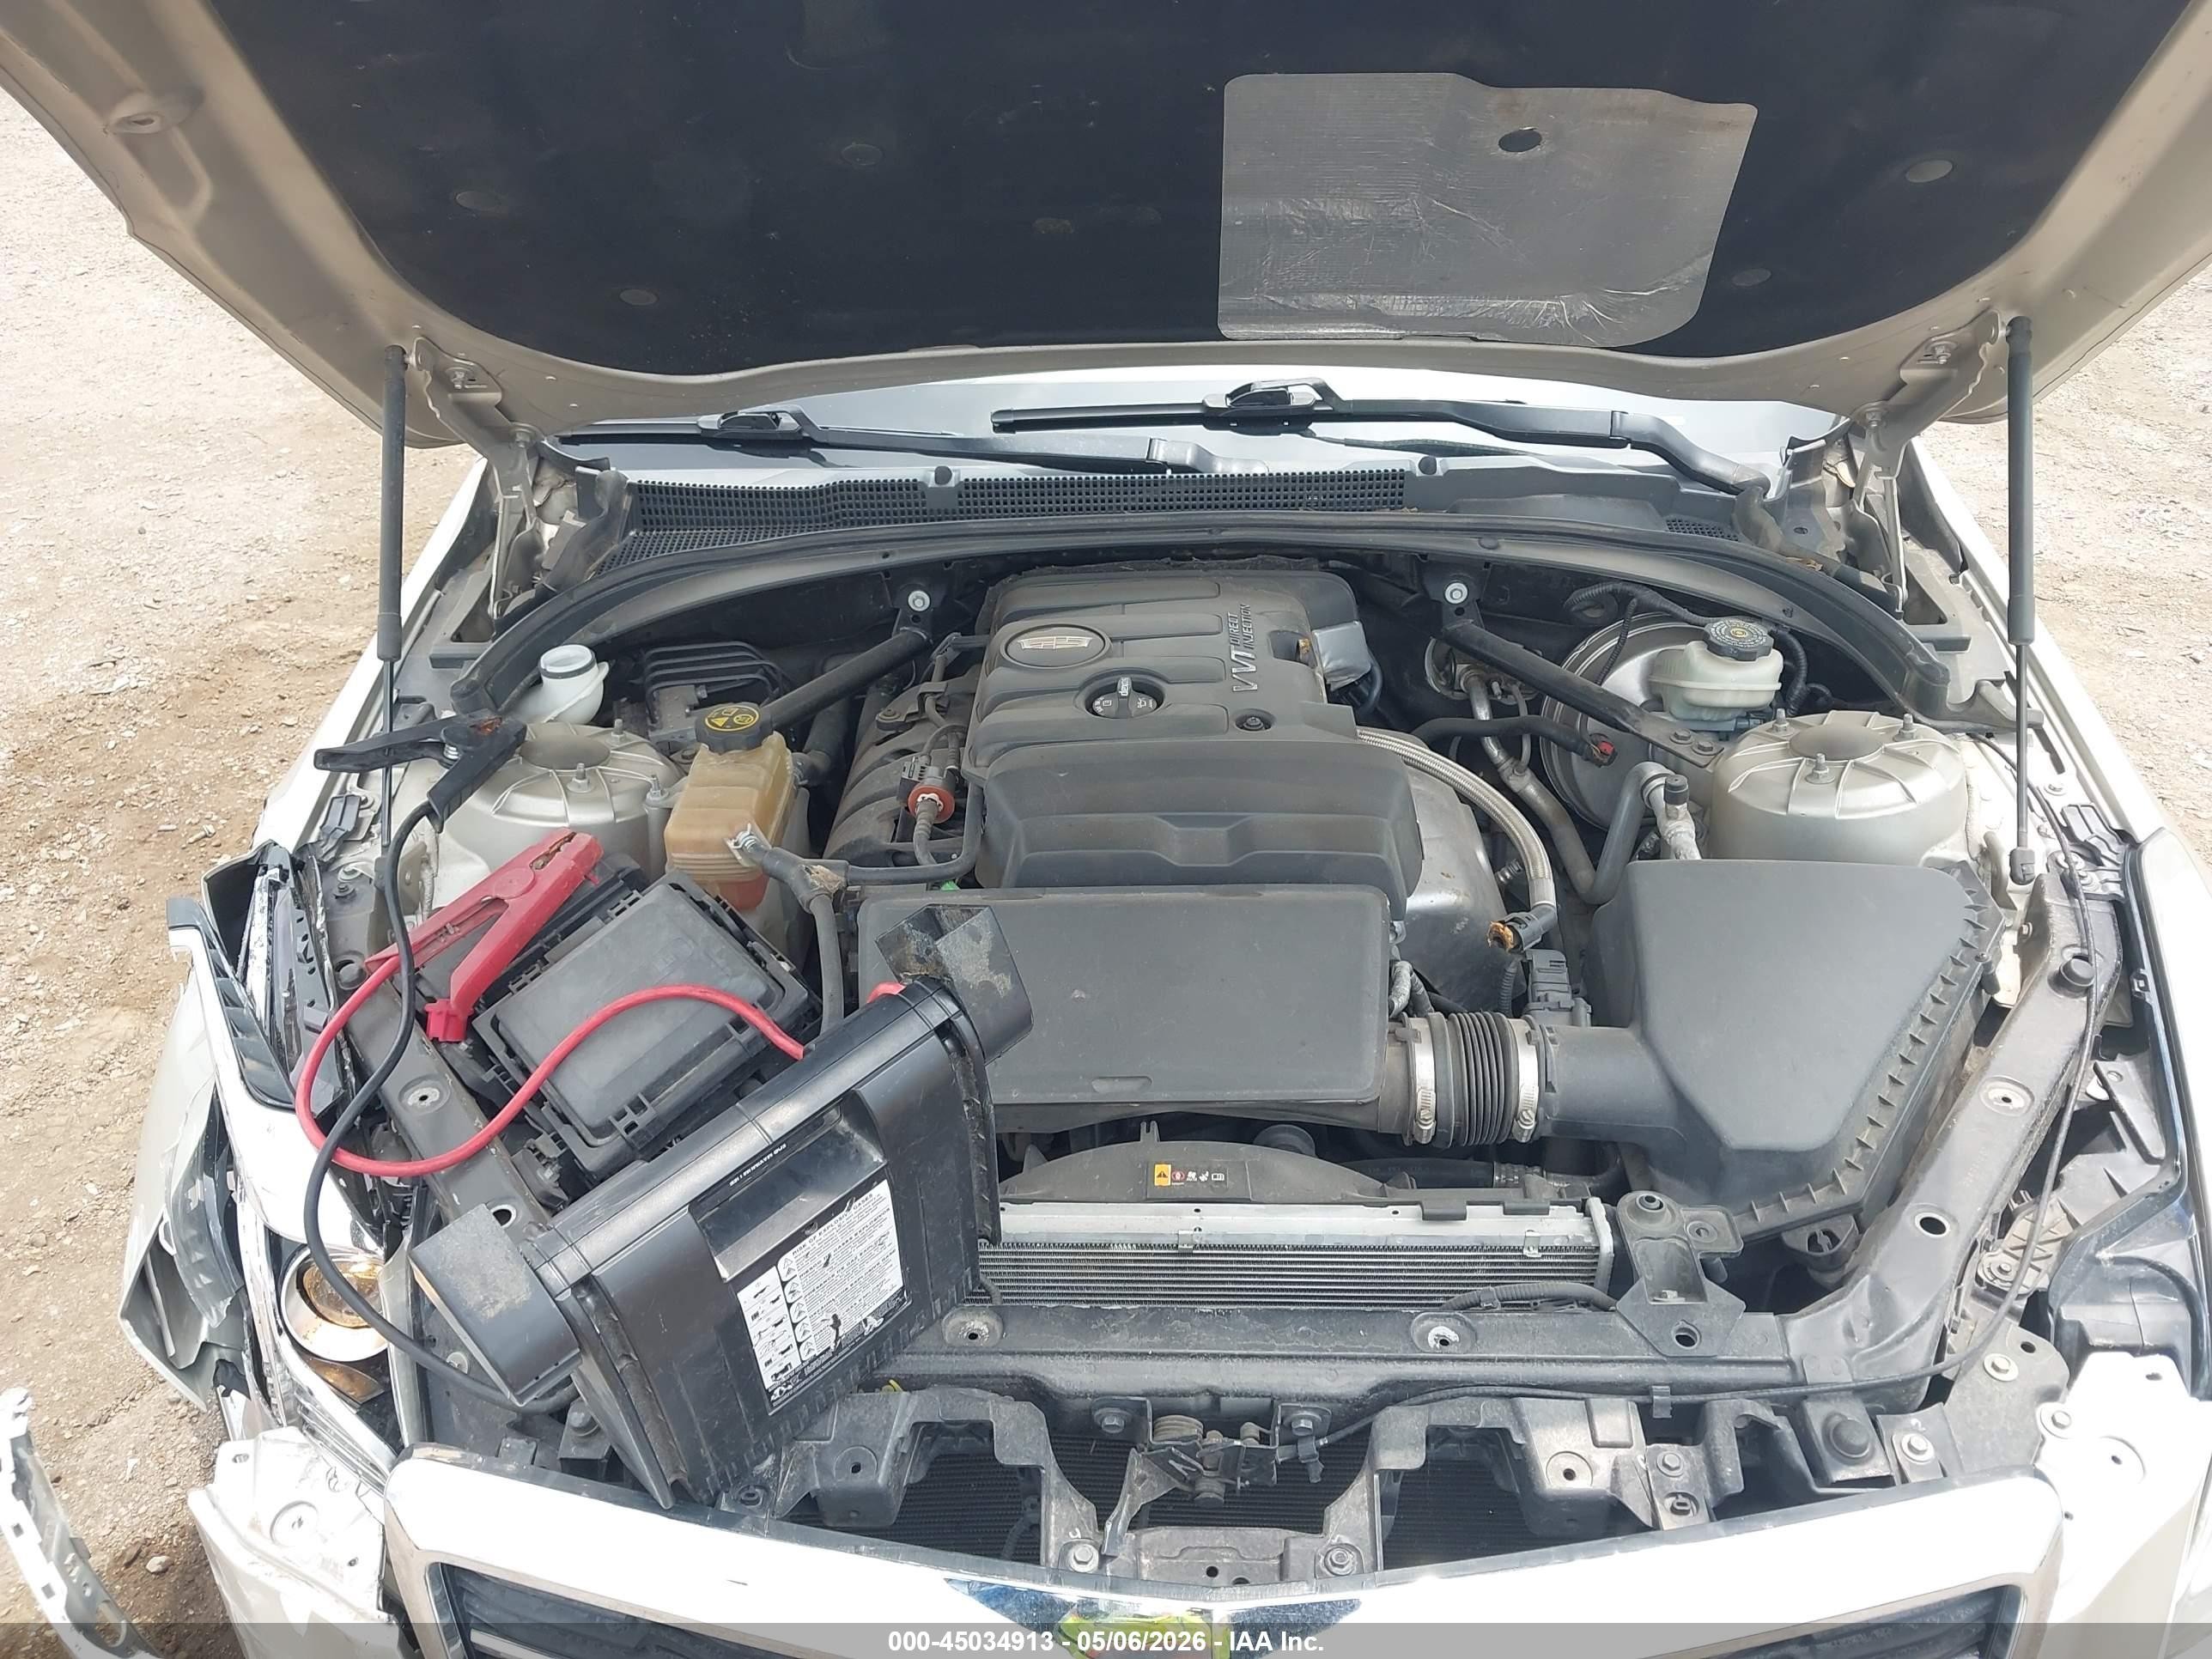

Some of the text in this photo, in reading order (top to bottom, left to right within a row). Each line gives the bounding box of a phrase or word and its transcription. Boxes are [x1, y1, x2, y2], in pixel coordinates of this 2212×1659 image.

[1228, 611, 1240, 646] DIRECT
[1240, 604, 1254, 649] INJECTION
[1230, 645, 1258, 691] VVT
